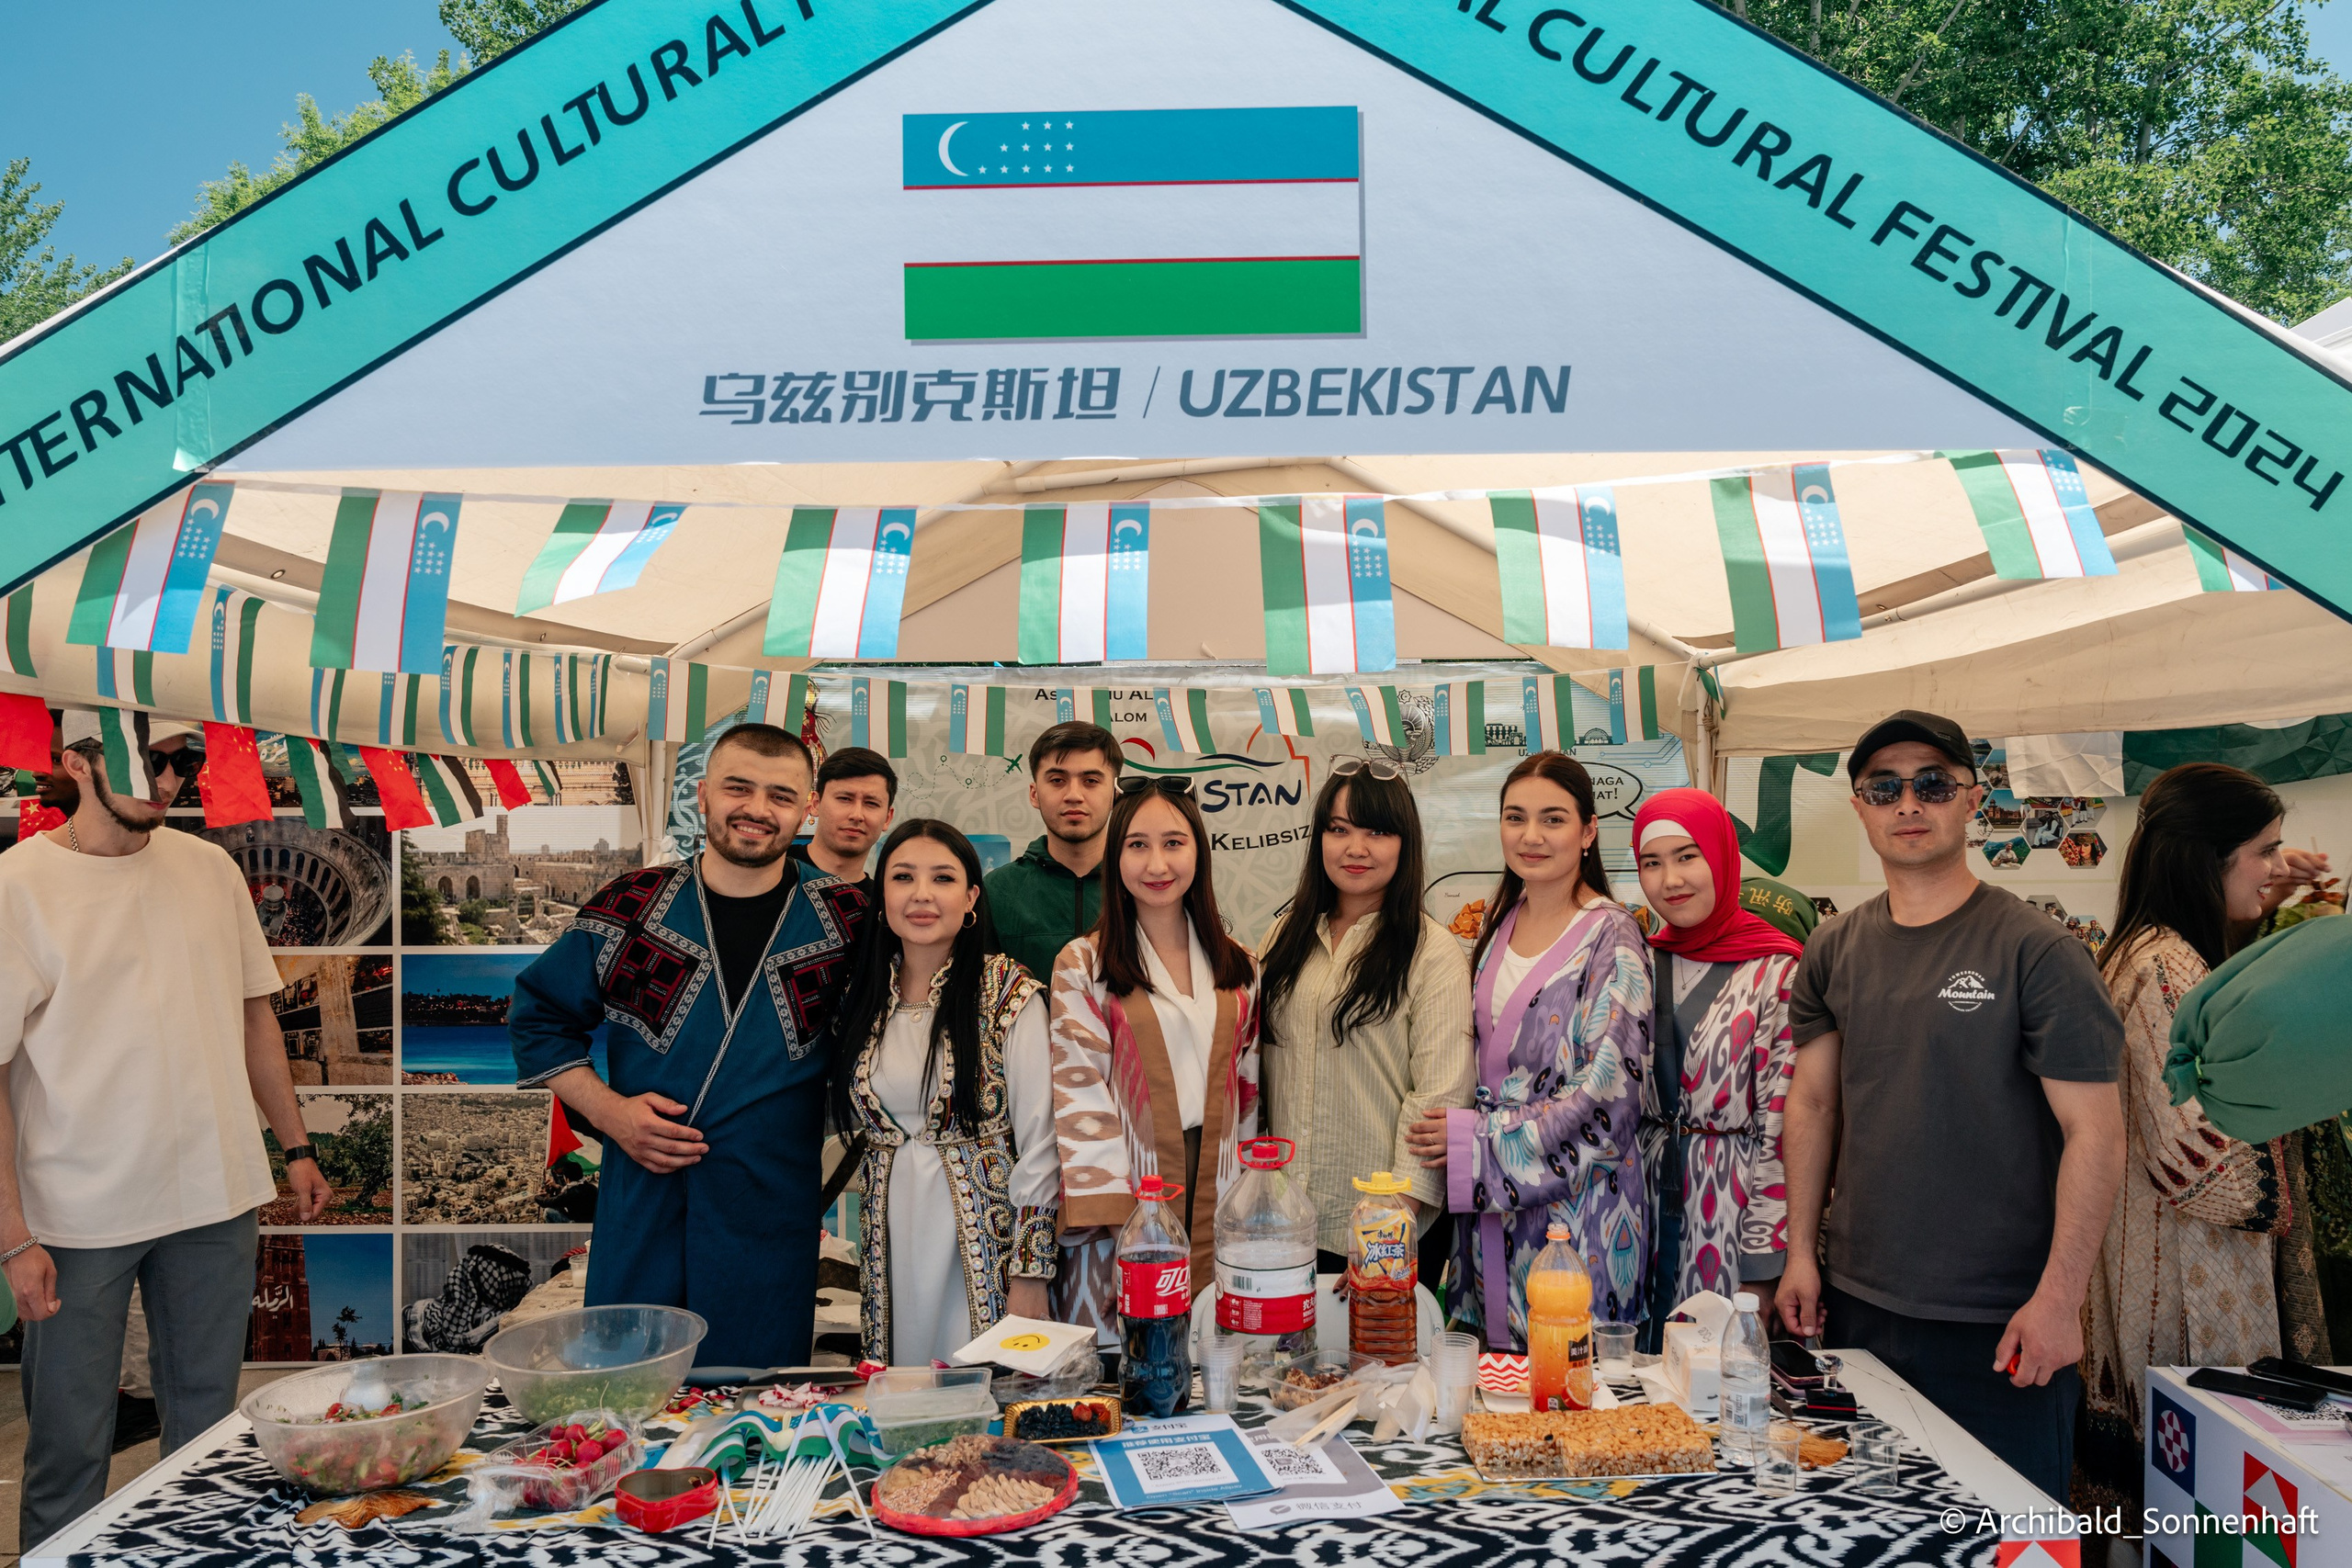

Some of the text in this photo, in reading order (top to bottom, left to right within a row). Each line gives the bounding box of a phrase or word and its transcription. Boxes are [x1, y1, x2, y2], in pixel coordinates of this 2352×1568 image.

[0, 0, 786, 507] TERNATIONAL CULTURAL
[1528, 9, 2346, 511] CULTURAL FESTIVAL 2024
[698, 367, 1121, 424] 乌兹别克斯坦
[1179, 366, 1572, 417] UZBEKISTAN
[1938, 988, 1996, 999] Mountain
[1364, 1241, 1405, 1269] 冰红茶
[1295, 1501, 1363, 1511] 微信支付
